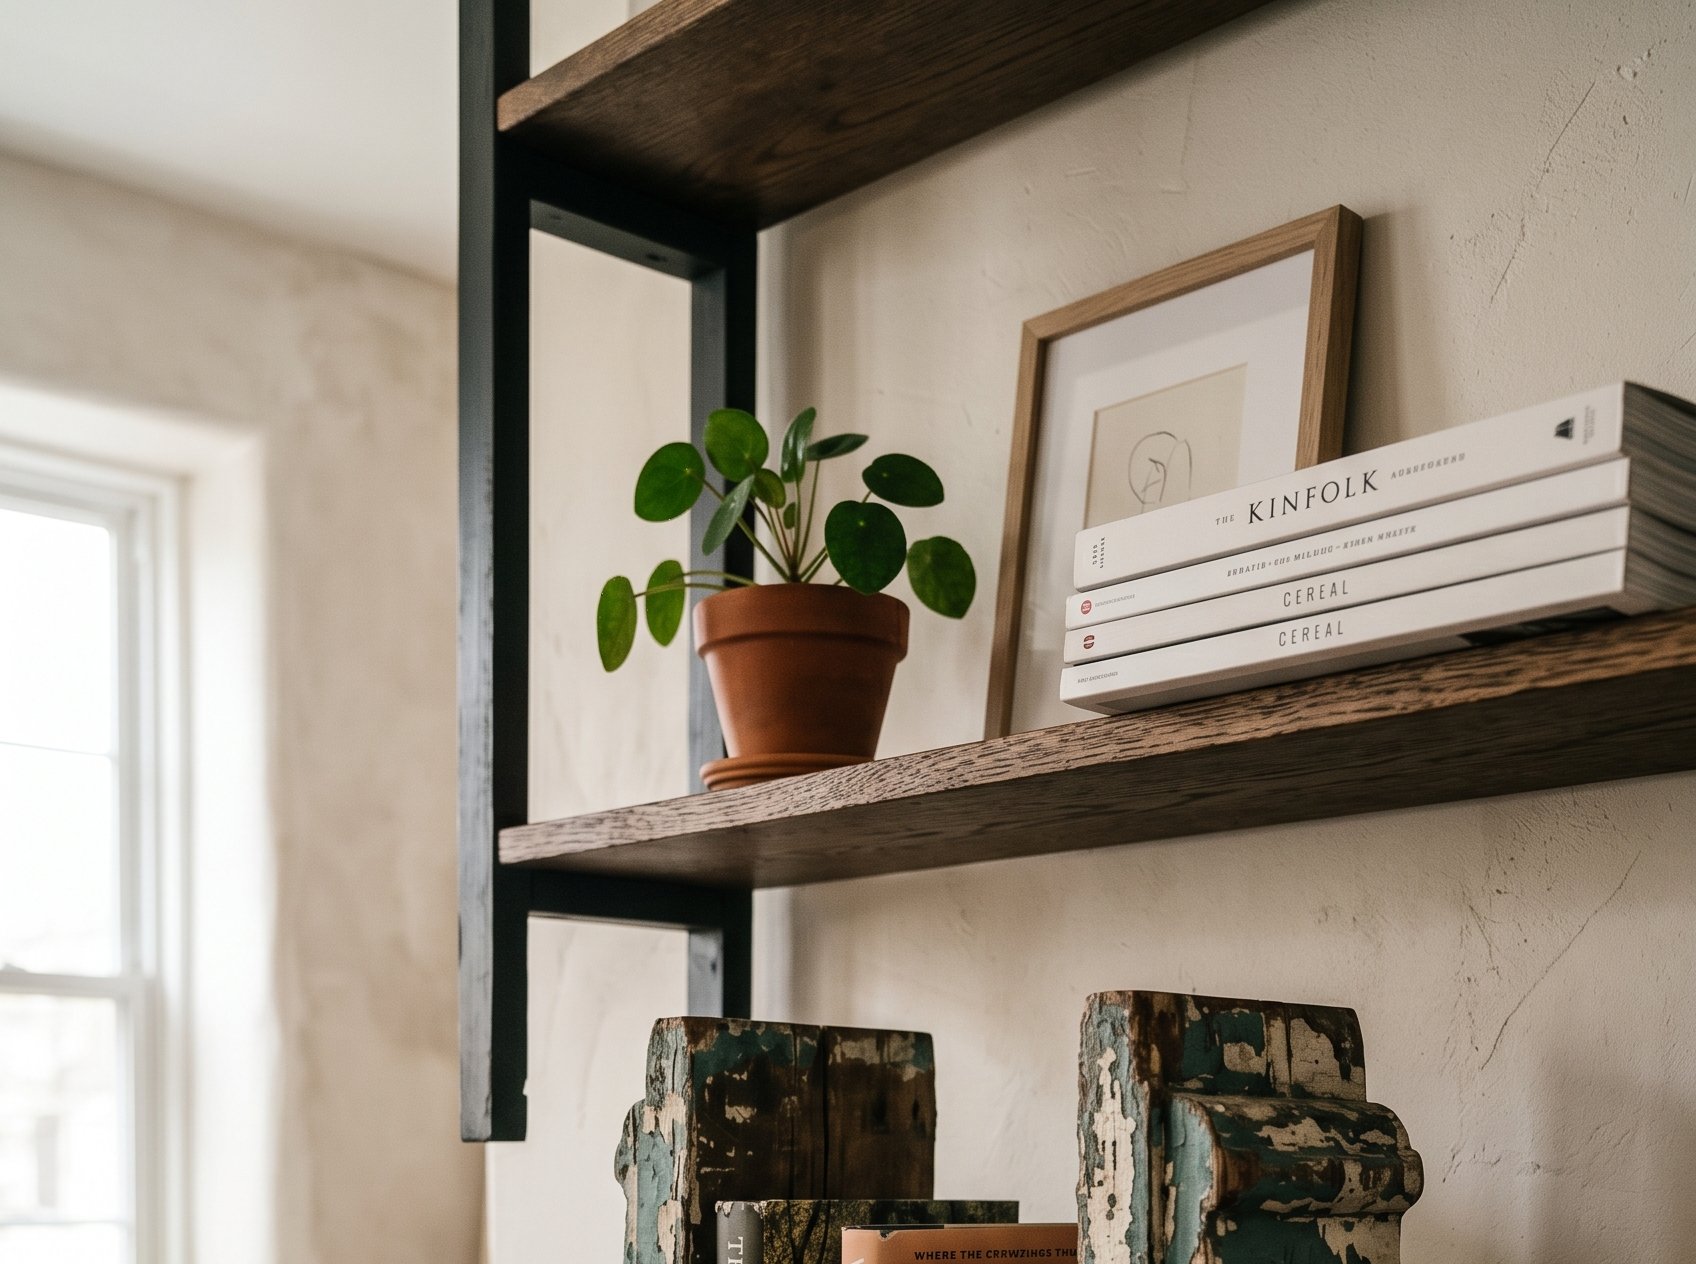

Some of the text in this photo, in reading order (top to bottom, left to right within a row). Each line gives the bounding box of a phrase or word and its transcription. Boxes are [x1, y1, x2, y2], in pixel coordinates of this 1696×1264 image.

[1215, 514, 1236, 526] THE
[1248, 469, 1380, 525] KINFOLK
[1283, 579, 1350, 608] CEREAL
[1278, 620, 1344, 647] CEREAL
[914, 1250, 956, 1261] WHERE
[960, 1250, 983, 1260] THE
